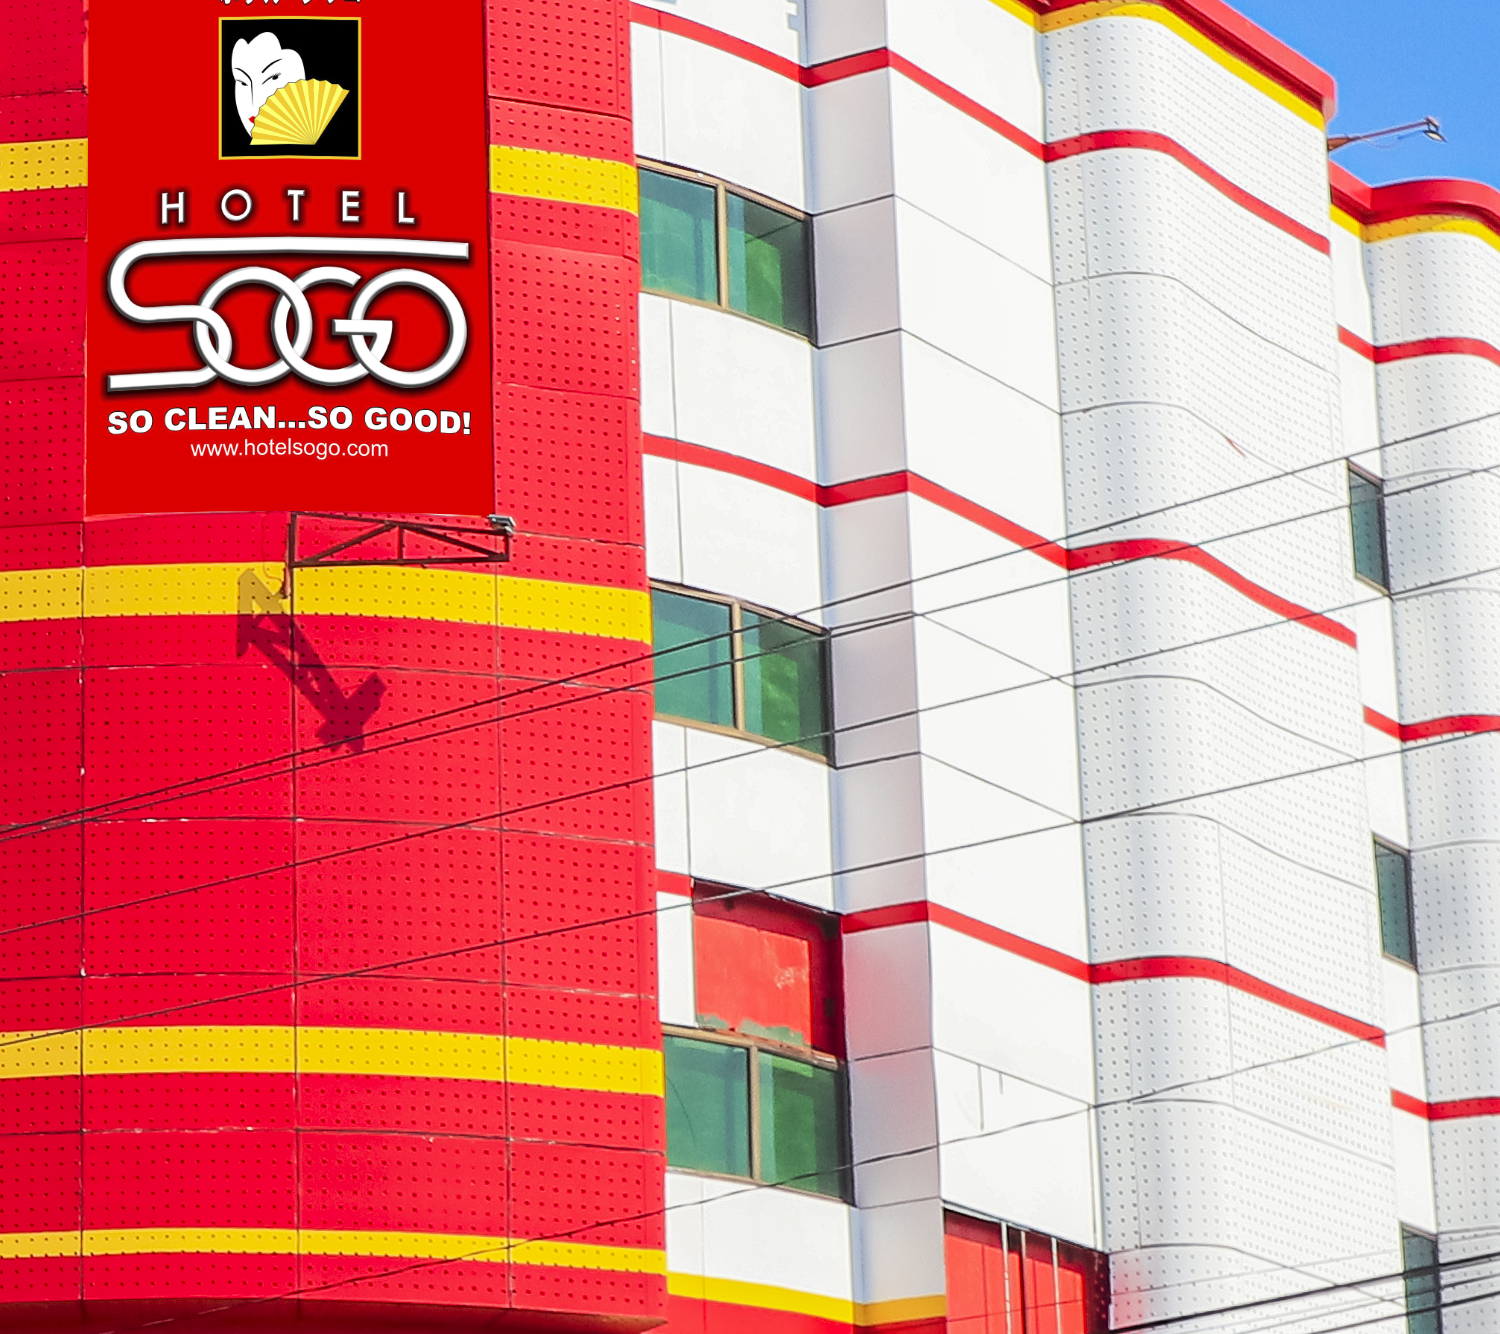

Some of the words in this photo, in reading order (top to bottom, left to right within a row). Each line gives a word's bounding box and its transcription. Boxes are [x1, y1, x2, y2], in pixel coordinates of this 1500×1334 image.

[160, 189, 415, 224] HOTEL
[107, 236, 471, 392] SOGO
[107, 410, 154, 435] SO
[364, 408, 472, 435] GOOD!
[190, 438, 389, 460] www.hotelsogo.com
